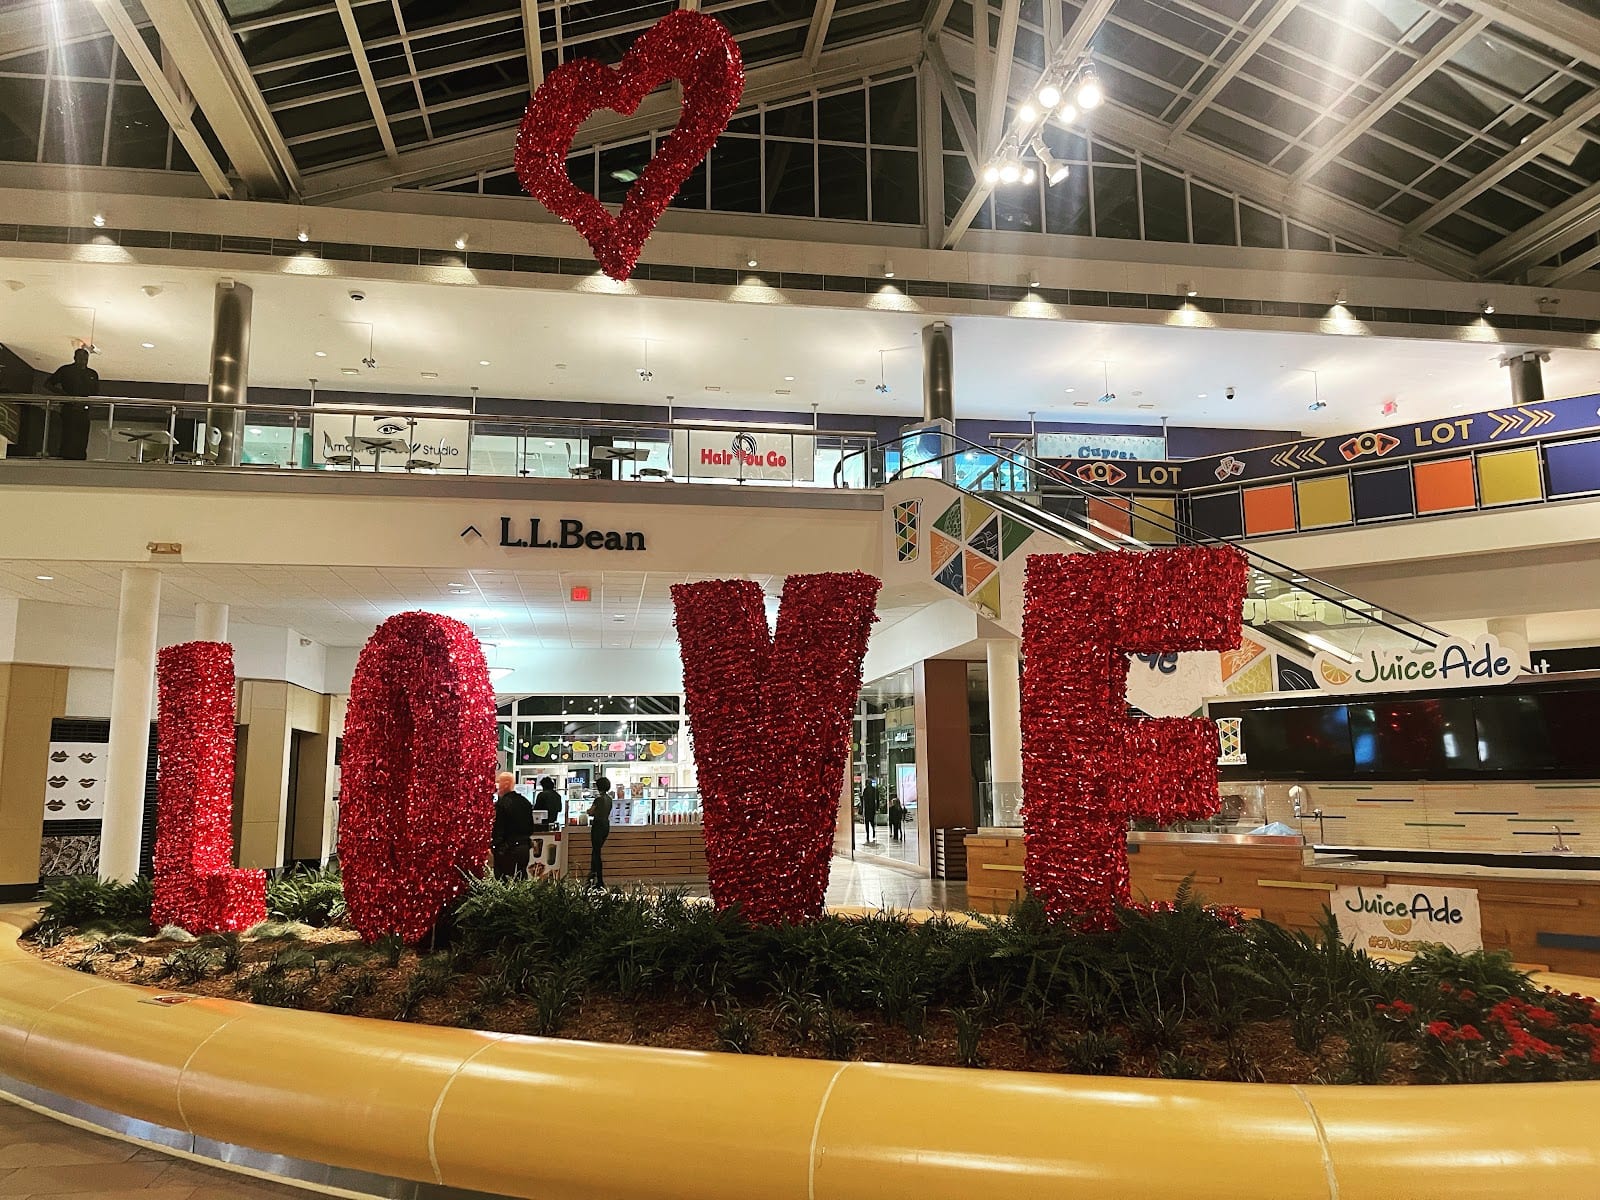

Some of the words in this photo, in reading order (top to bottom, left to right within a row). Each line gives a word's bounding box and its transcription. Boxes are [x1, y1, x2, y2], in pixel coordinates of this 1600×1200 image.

[423, 445, 459, 456] Studio
[1341, 433, 1397, 460] TOT
[1414, 419, 1474, 447] LOT
[701, 449, 733, 465] Hair
[736, 450, 764, 467] You
[767, 451, 787, 467] Go
[1079, 461, 1126, 484] TOT
[1137, 466, 1182, 485] LOT
[500, 517, 646, 550] L.L.Bean
[1355, 643, 1511, 683] JuiceAde
[1345, 887, 1463, 924] JuiceAde
